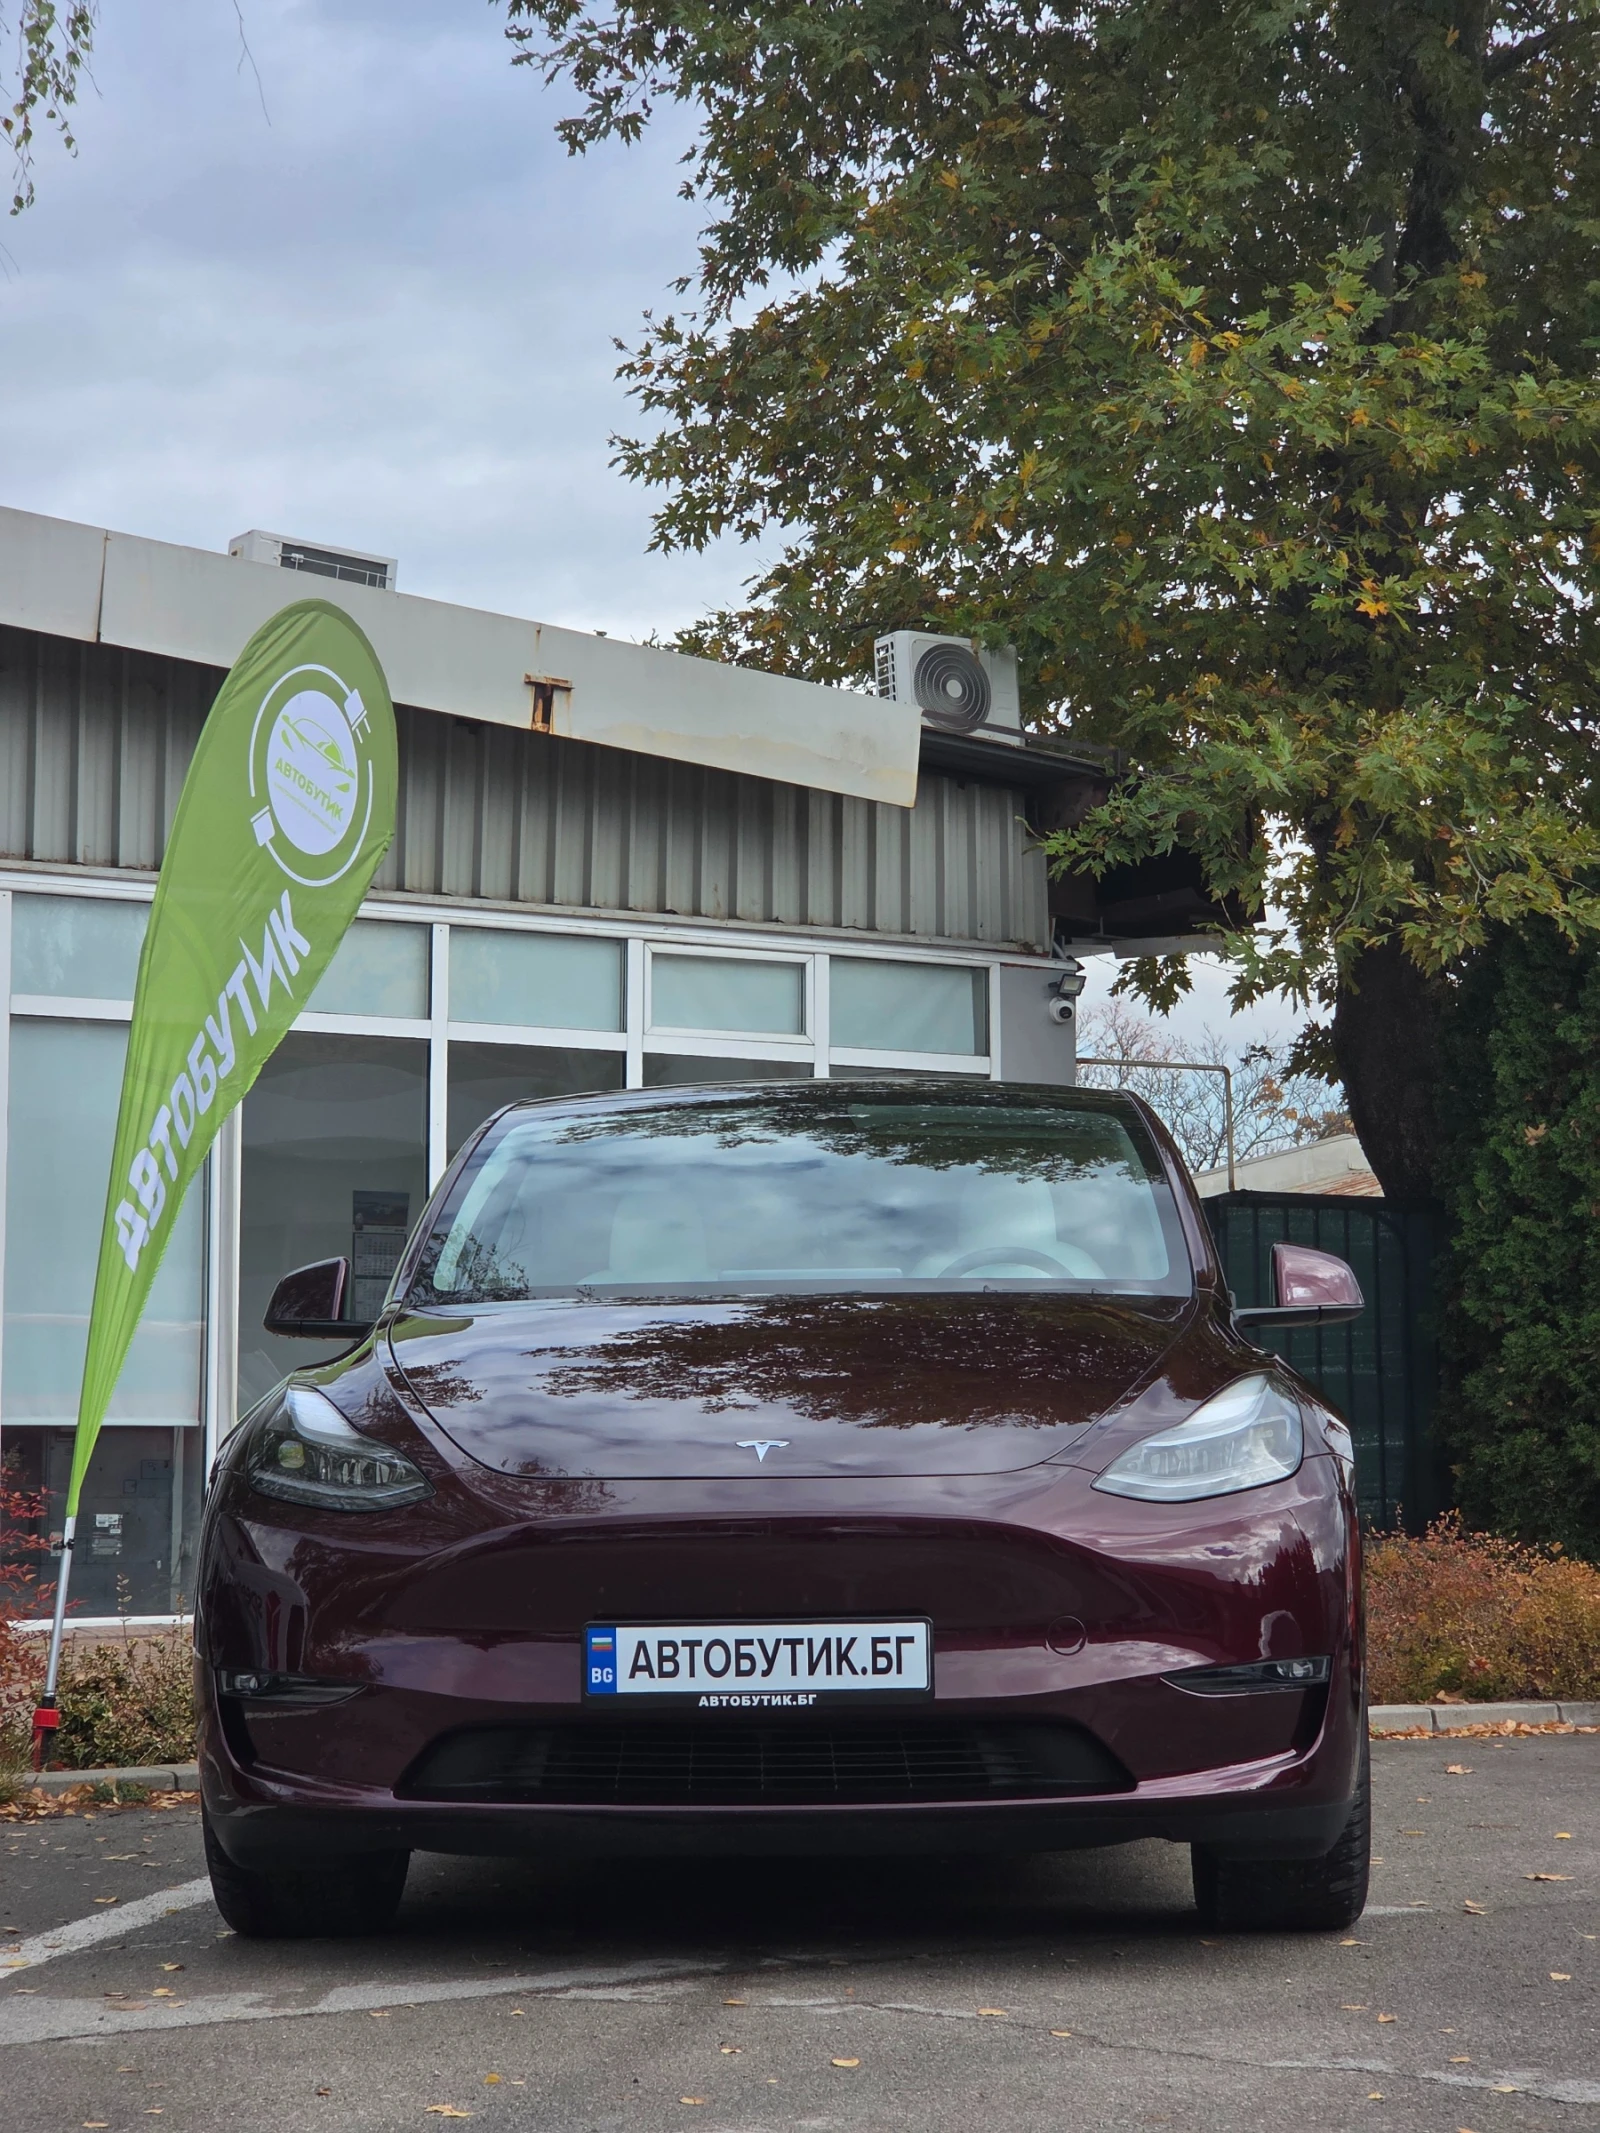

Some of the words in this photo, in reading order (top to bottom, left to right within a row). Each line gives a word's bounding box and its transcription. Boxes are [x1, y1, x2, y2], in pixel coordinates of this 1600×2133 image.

[275, 757, 343, 822] АВТОБУТИК
[115, 889, 311, 1273] АВТОБУТИК
[591, 1668, 613, 1684] BG
[628, 1636, 915, 1679] АВТОБУТИК.БГ
[698, 1694, 817, 1708] АВТОБУТИК.БГ
